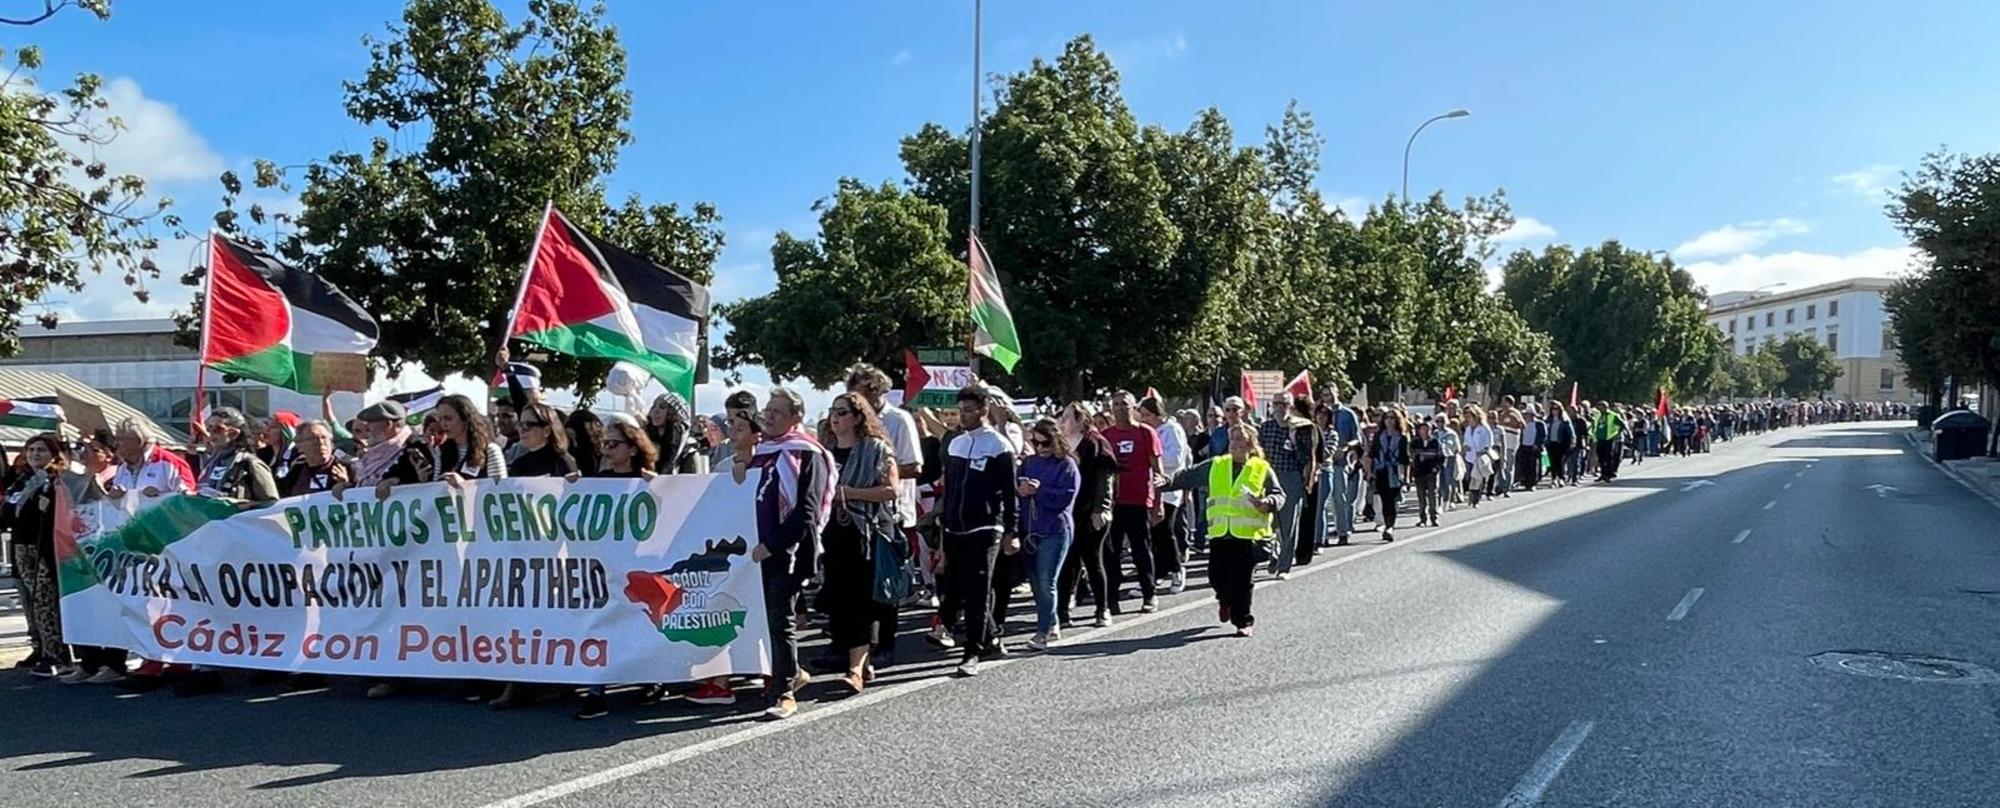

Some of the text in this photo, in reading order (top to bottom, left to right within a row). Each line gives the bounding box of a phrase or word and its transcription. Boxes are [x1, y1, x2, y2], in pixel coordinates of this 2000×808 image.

[285, 491, 657, 548] PAREMOS EL GENOCIDIO
[84, 545, 179, 600] ONTRA
[218, 551, 383, 609] OCUPACIÓN
[391, 560, 410, 608] Y
[420, 559, 448, 608] EL
[457, 558, 610, 610] APARTHEID
[671, 568, 711, 589] CÁDIZ
[153, 614, 609, 667] Cádiz con Palestina
[661, 610, 732, 630] PALESTINA
